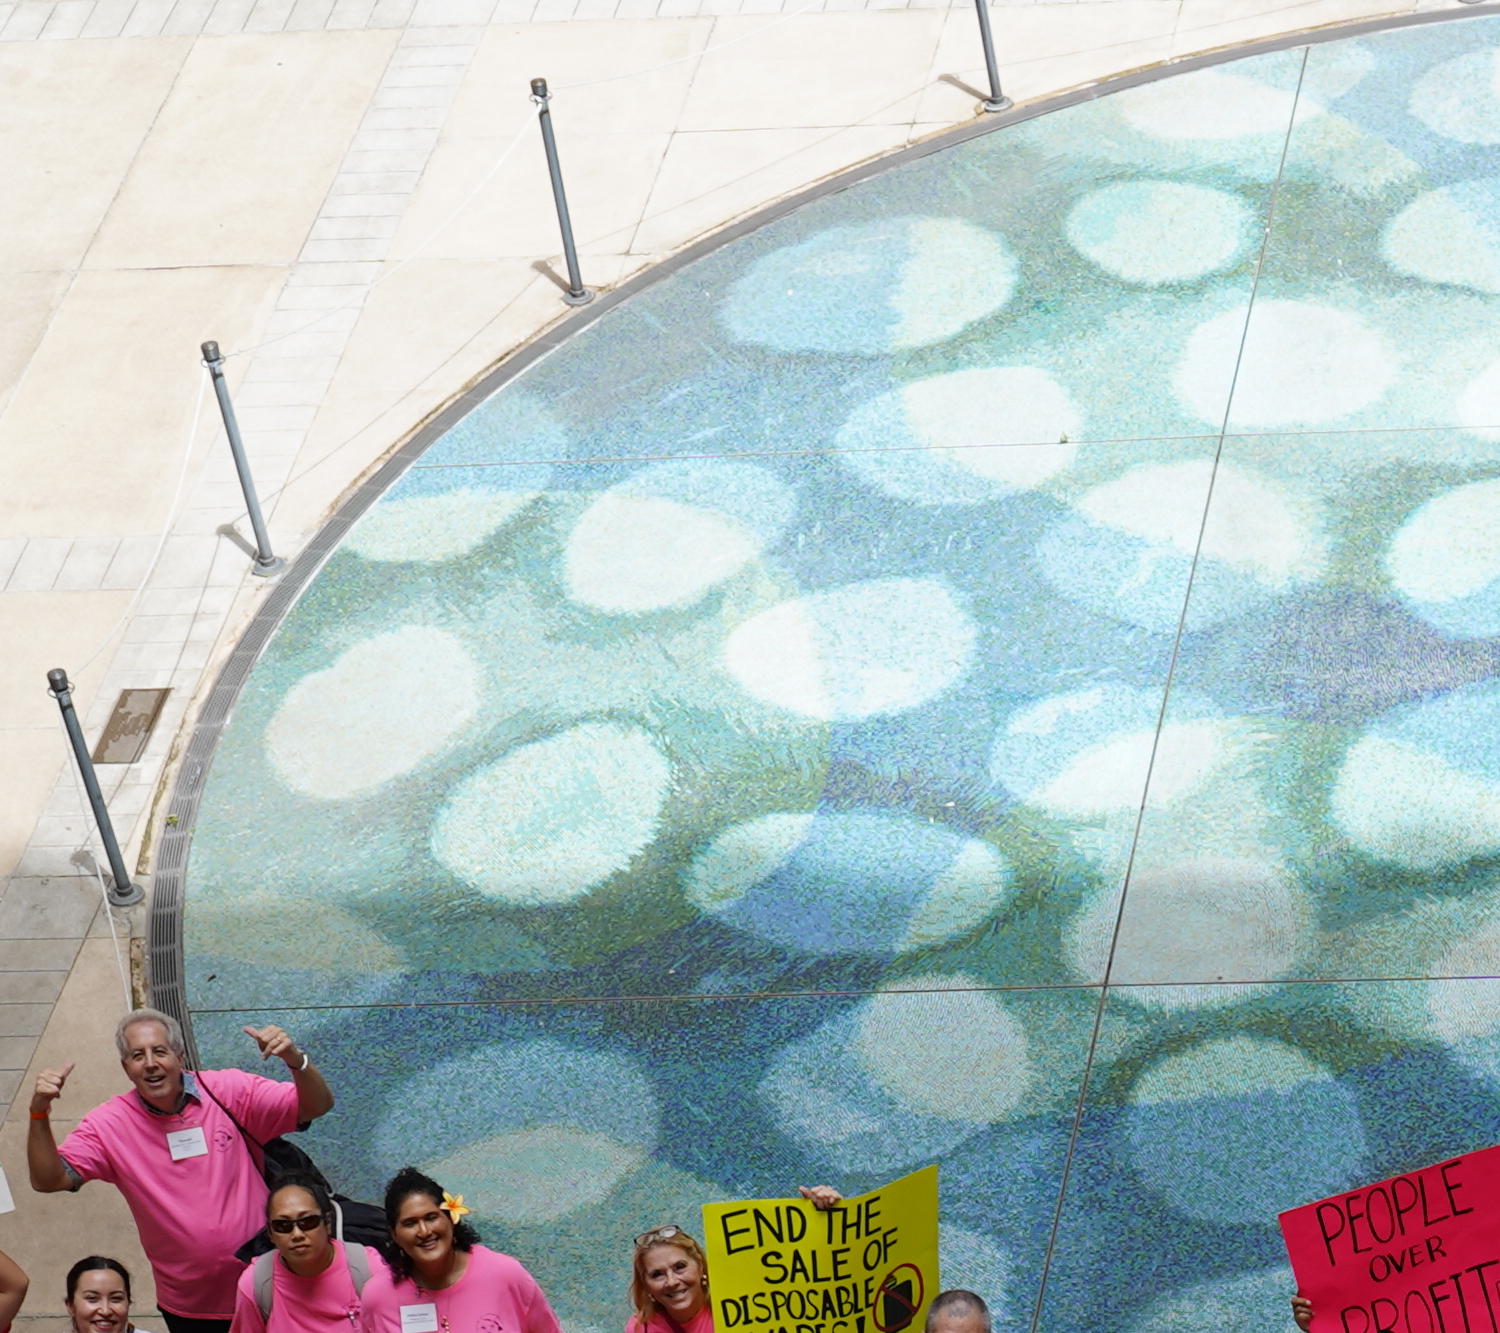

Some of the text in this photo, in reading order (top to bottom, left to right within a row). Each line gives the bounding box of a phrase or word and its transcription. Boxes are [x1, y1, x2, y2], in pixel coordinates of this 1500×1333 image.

[720, 1196, 883, 1257] END THE
[1316, 1160, 1474, 1267] PEOPLE
[761, 1228, 898, 1286] SALE OF
[1368, 1235, 1447, 1284] OVER
[721, 1282, 876, 1329] DISPOSABLE
